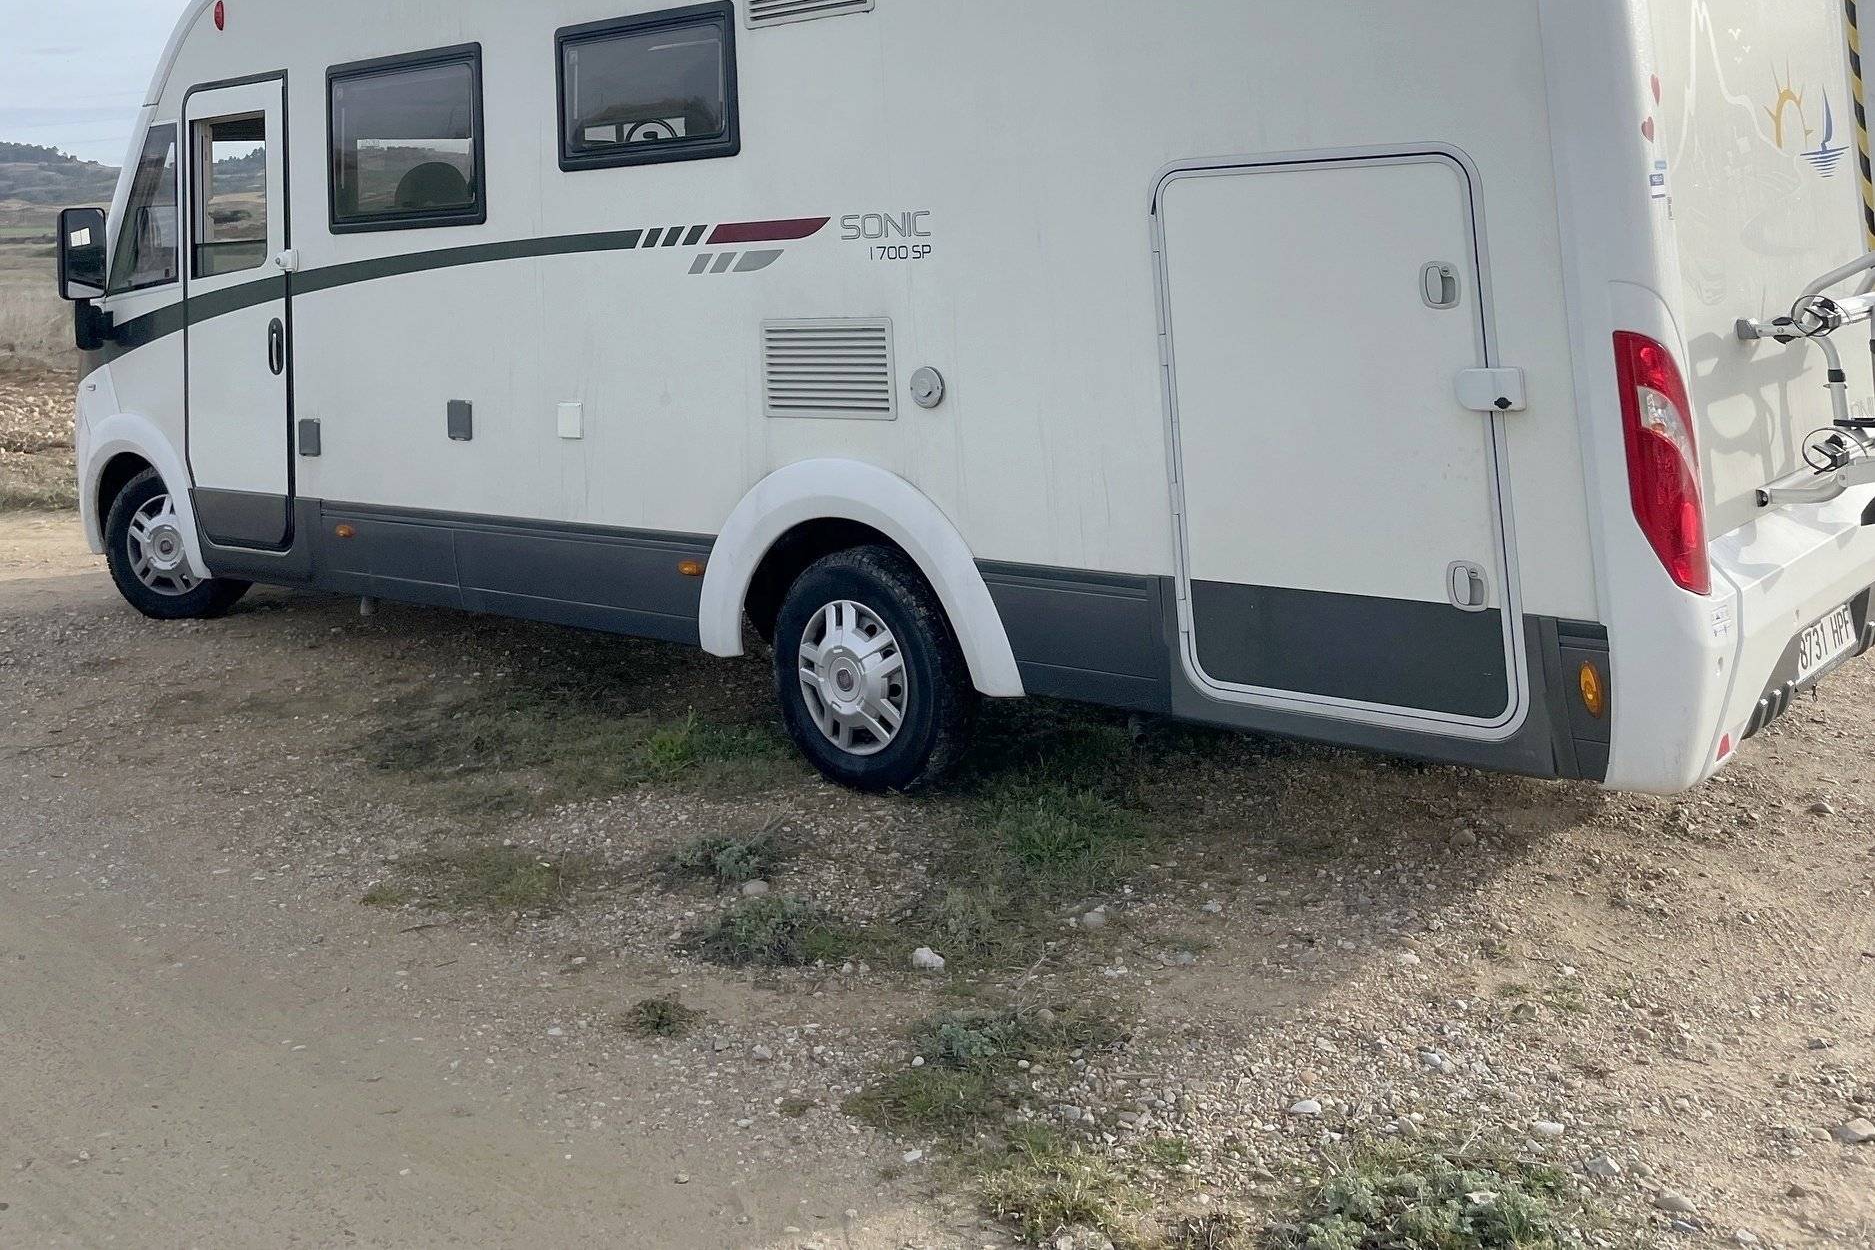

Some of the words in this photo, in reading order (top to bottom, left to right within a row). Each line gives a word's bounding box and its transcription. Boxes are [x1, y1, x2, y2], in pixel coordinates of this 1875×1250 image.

[840, 211, 932, 240] SONIC
[911, 244, 932, 260] SP
[1799, 623, 1828, 670] 8731
[1829, 607, 1849, 649] HPF
